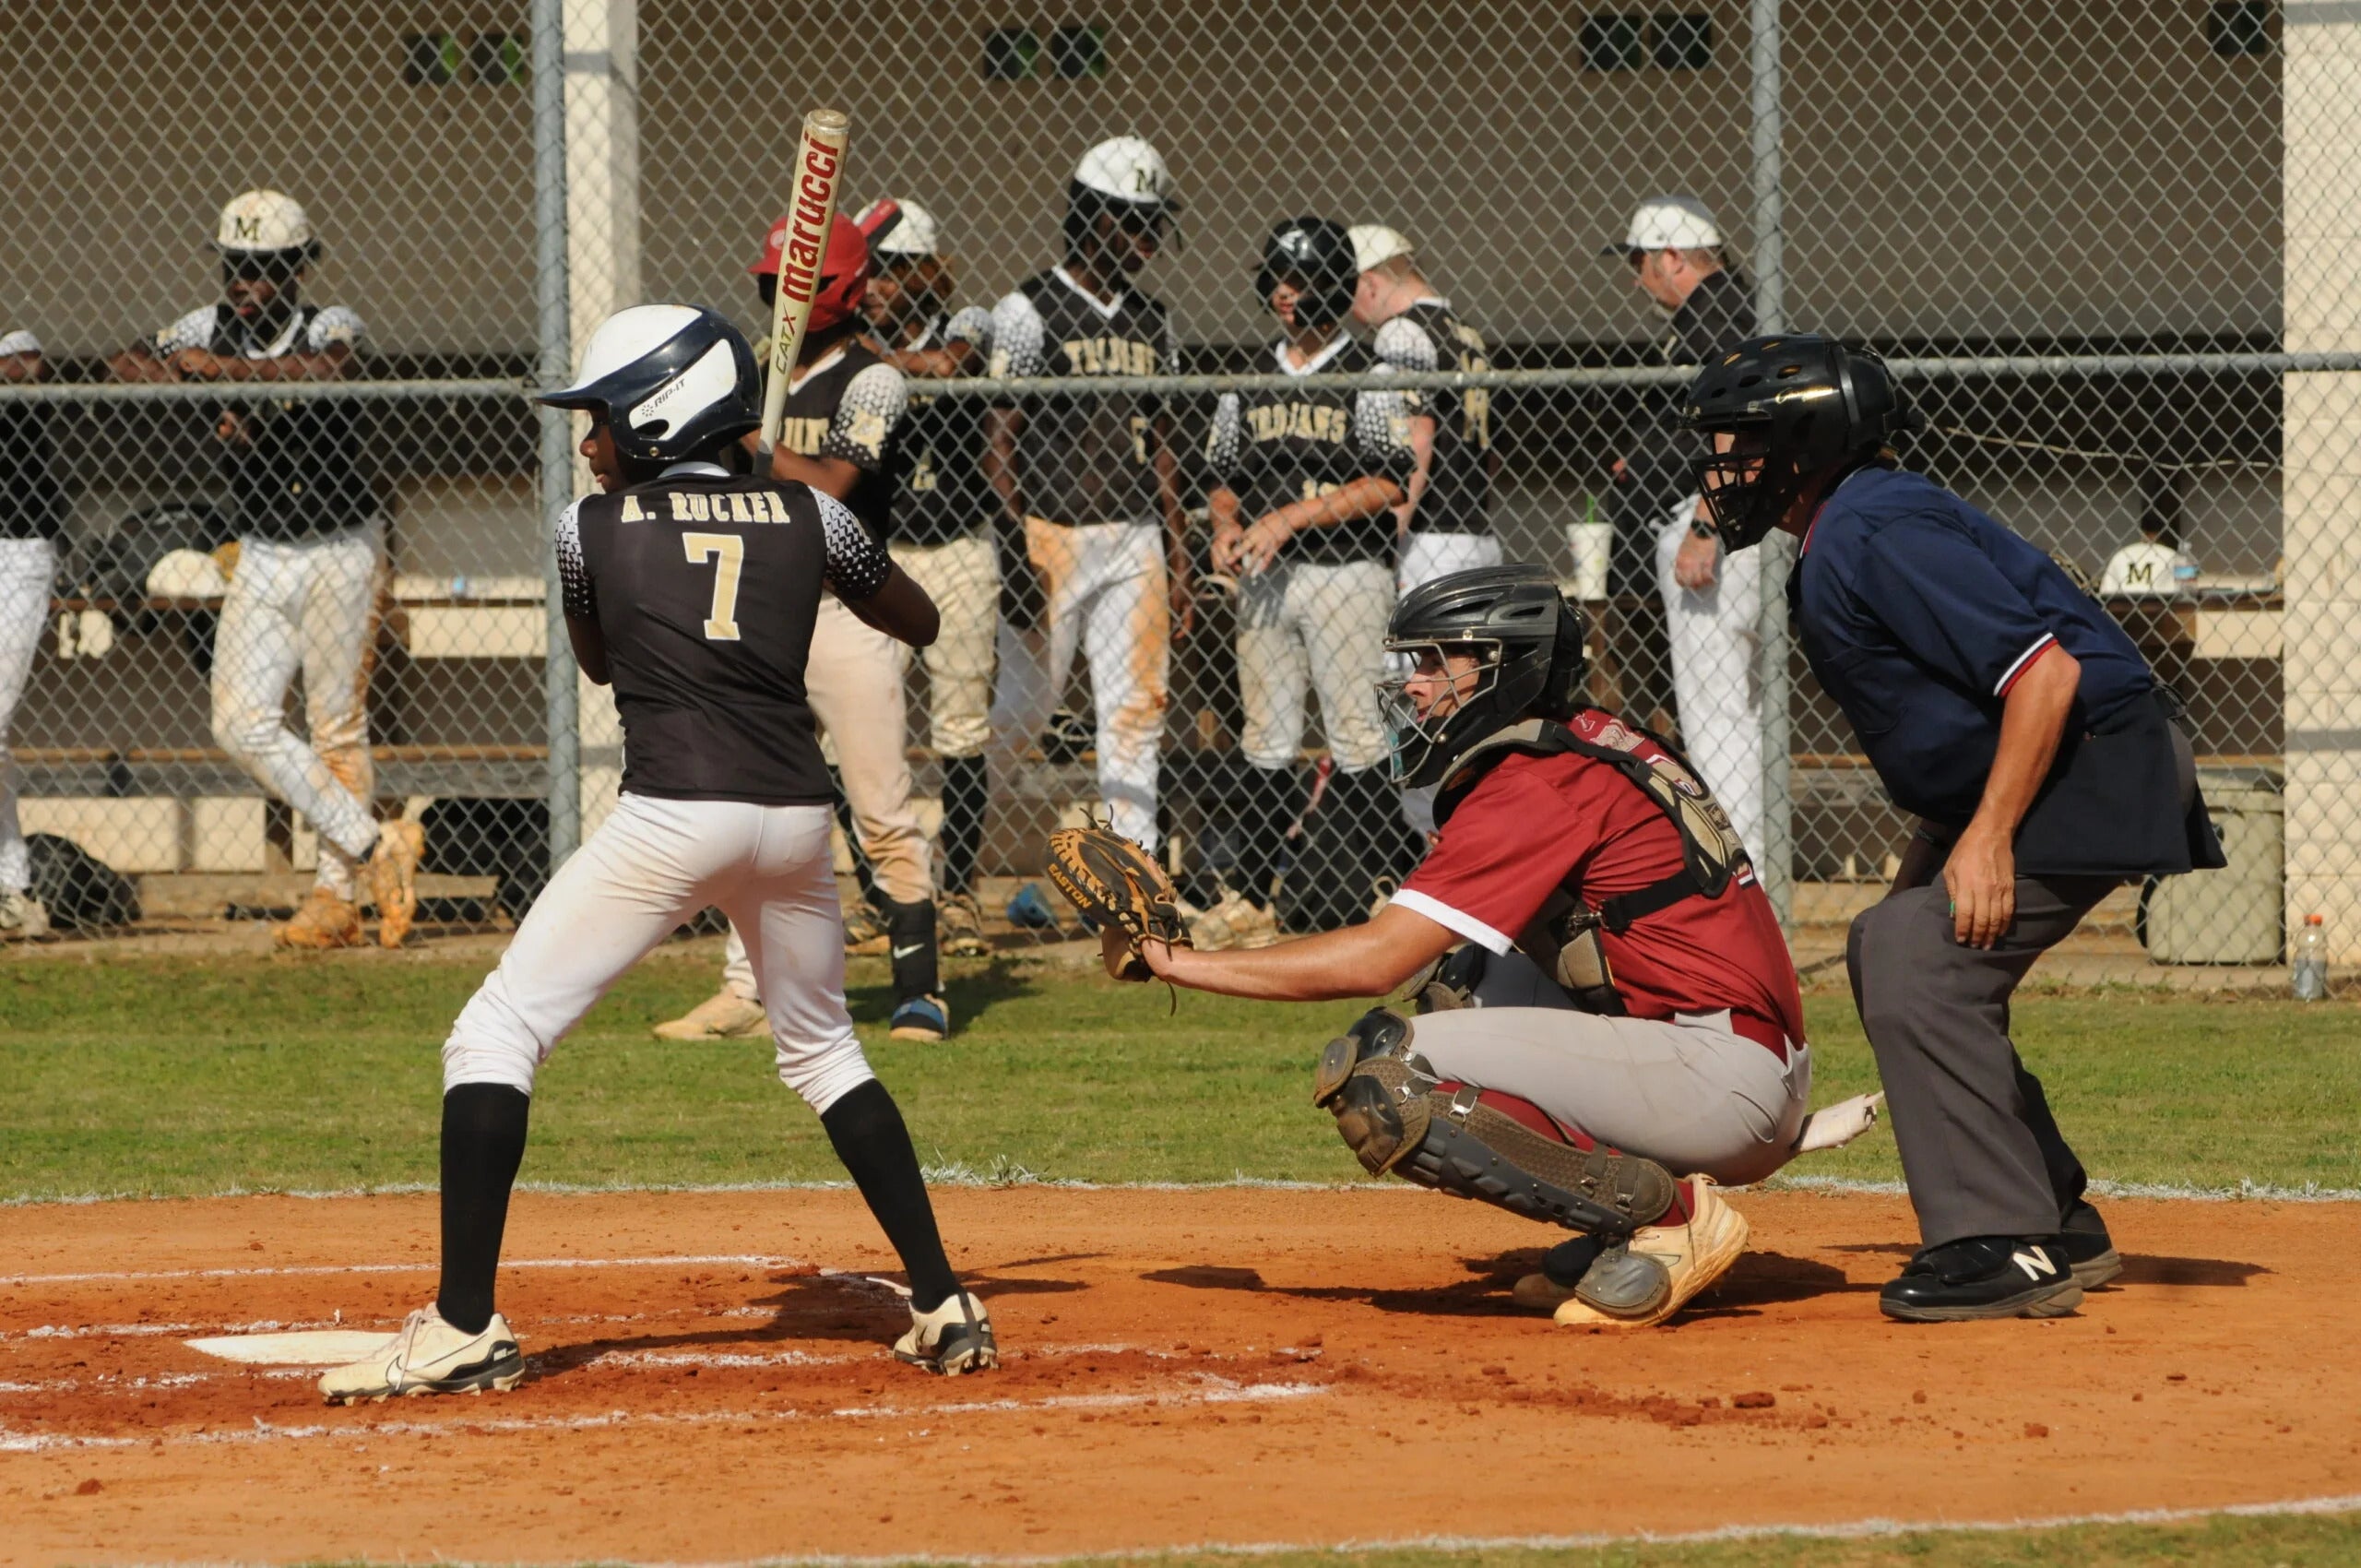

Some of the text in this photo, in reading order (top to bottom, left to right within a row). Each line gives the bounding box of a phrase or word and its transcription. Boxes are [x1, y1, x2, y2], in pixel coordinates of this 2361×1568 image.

[1134, 168, 1158, 193] M
[233, 216, 260, 243] M
[782, 130, 839, 303] marucci
[775, 302, 797, 375] CATX
[1246, 401, 1347, 445] TROJANS
[621, 491, 790, 524] A. RUCKER
[682, 531, 744, 641] 7
[2126, 561, 2153, 586] M
[1047, 862, 1093, 909] EASTON
[2012, 1245, 2058, 1282] N
